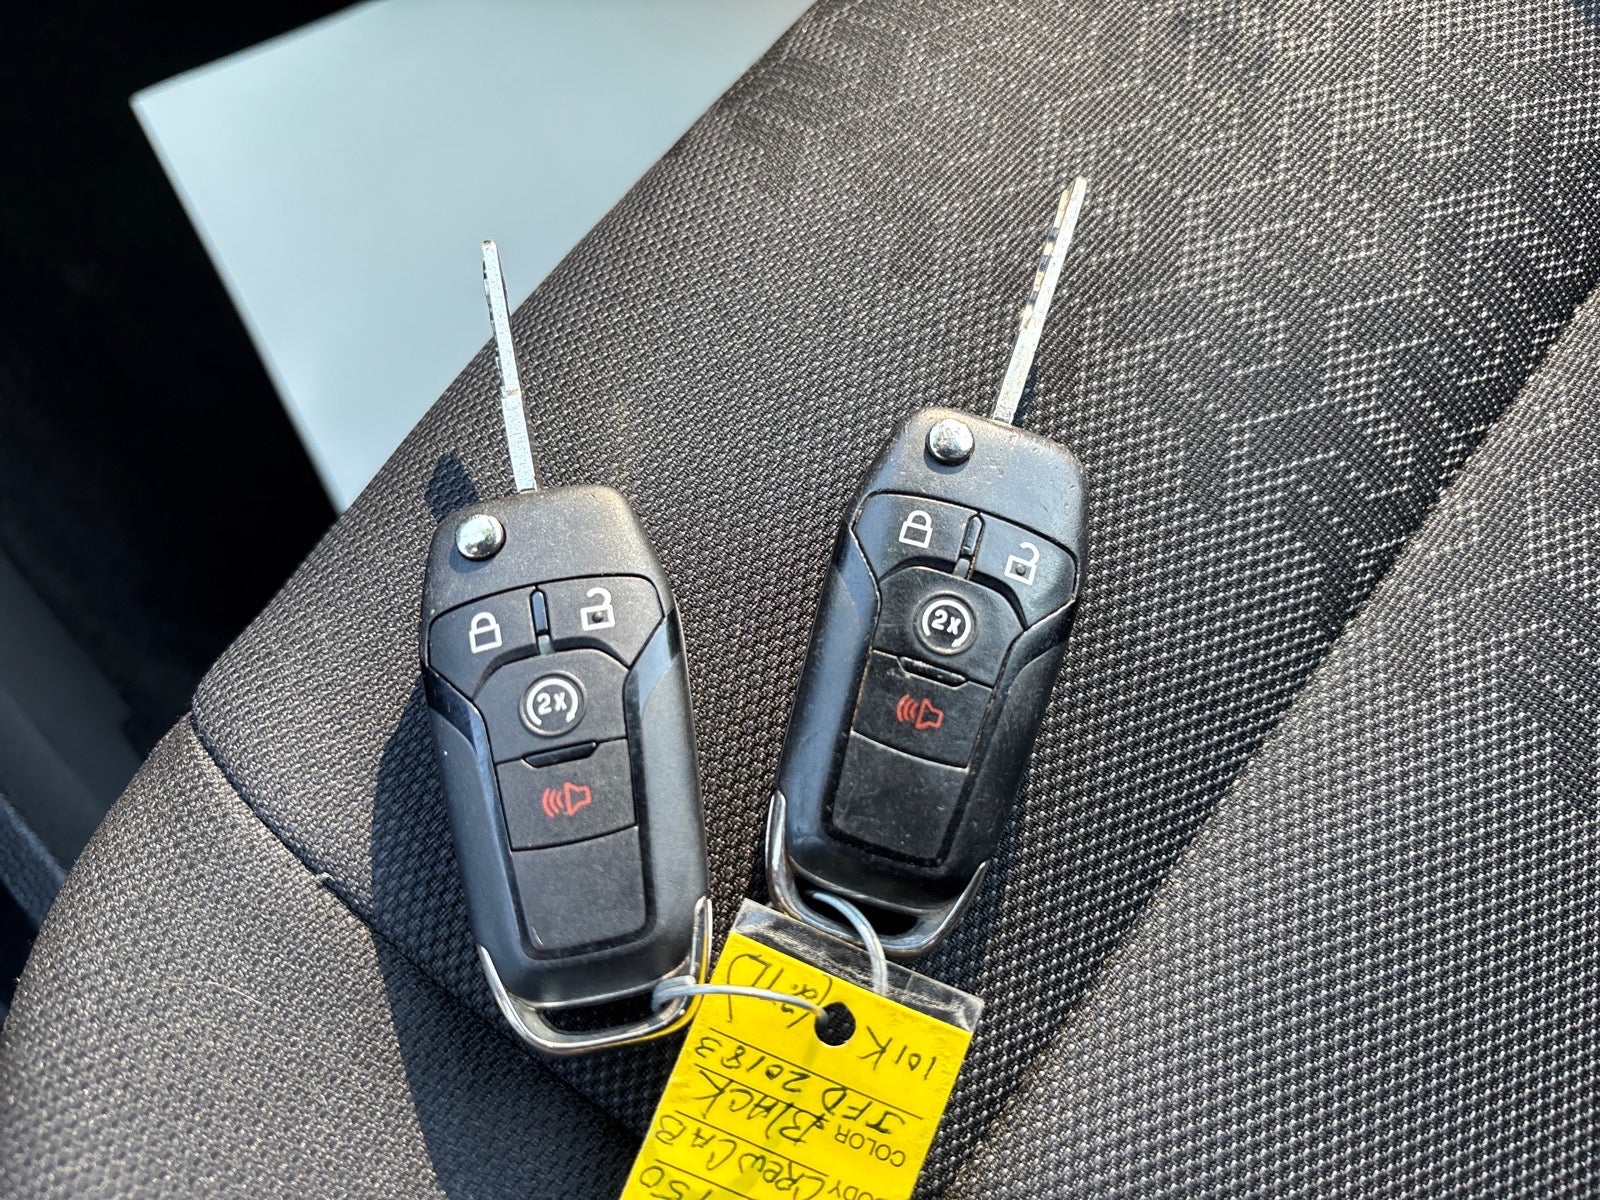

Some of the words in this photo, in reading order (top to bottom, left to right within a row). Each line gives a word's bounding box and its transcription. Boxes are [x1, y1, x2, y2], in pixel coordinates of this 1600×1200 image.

[693, 1037, 811, 1093] 20183
[857, 1025, 937, 1081] 101K
[821, 1086, 906, 1135] JFD
[655, 1114, 738, 1171] CAB
[833, 1124, 907, 1168] COLOR
